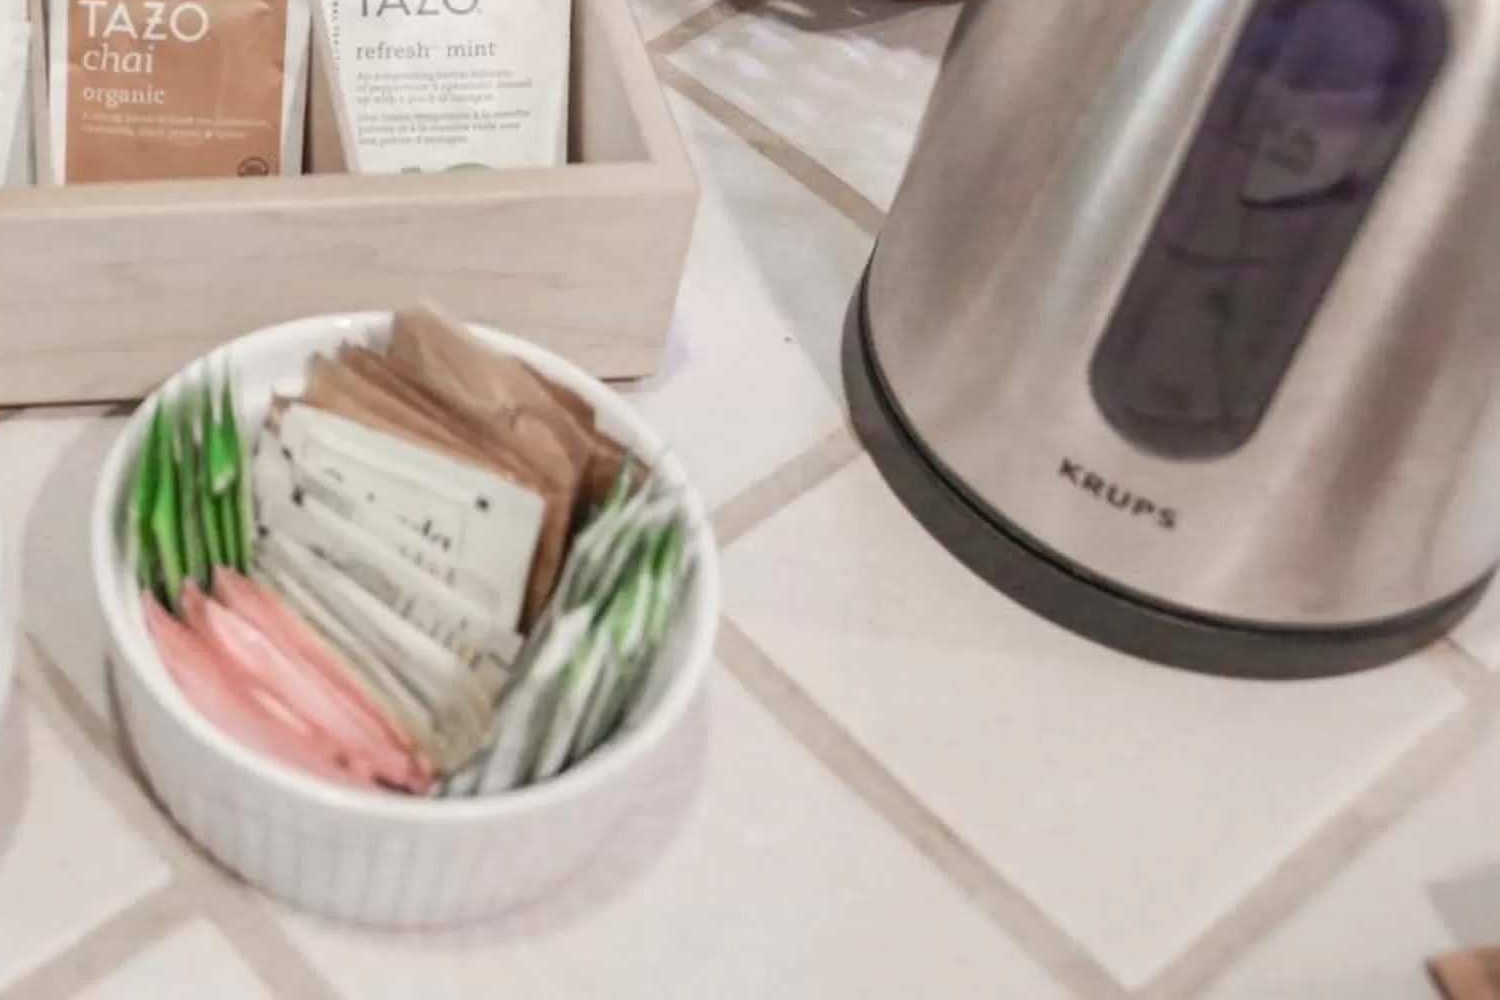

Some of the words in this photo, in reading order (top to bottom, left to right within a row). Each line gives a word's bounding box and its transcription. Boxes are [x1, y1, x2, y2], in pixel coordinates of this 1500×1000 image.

[79, 0, 209, 42] TAZO
[83, 43, 154, 73] chai
[356, 40, 429, 60] refresh
[447, 39, 497, 58] mint
[83, 84, 165, 109] organic
[1059, 457, 1177, 530] KRUPS
